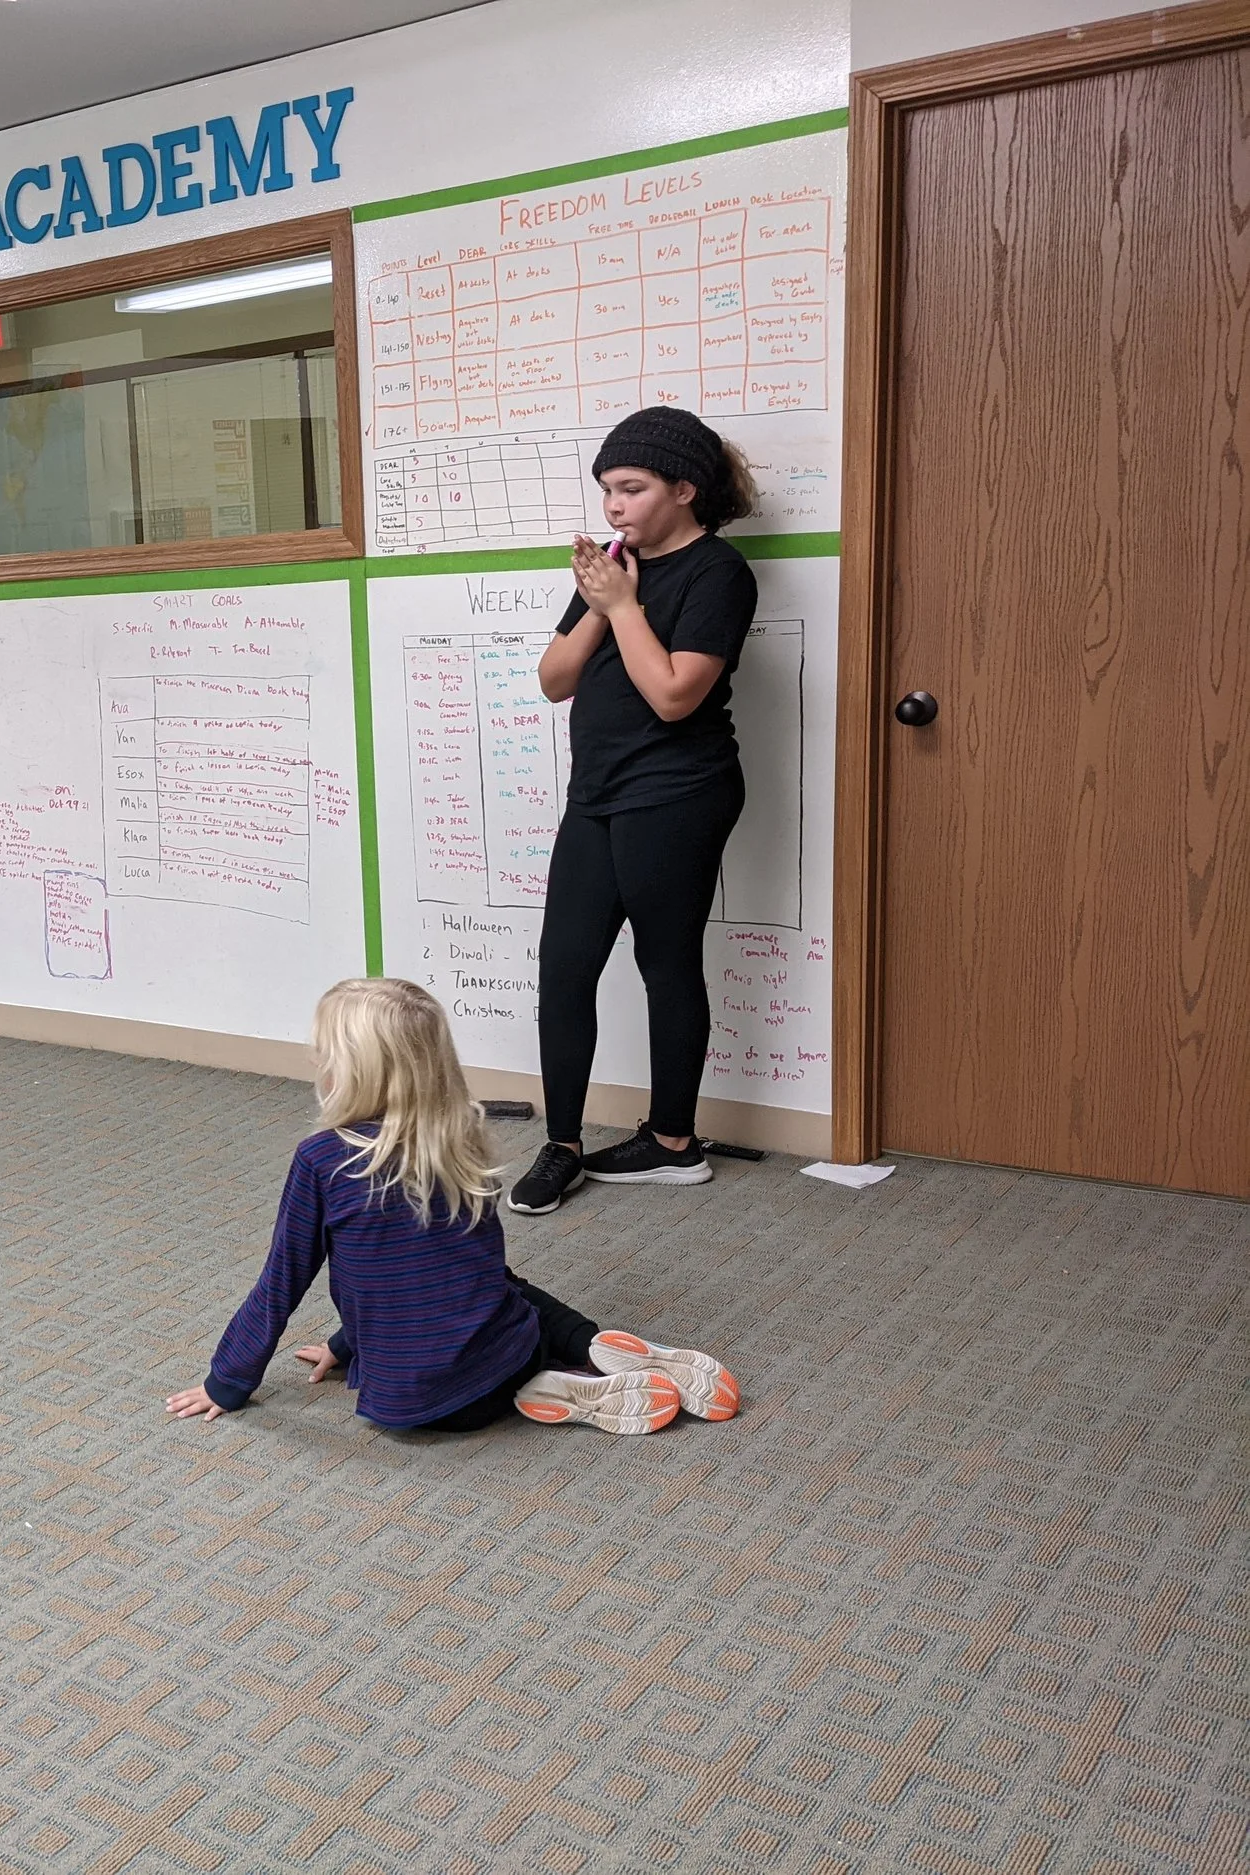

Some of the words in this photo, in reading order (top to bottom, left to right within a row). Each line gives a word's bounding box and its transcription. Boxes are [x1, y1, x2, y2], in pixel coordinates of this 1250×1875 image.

[500, 193, 607, 235] FREEDOM
[624, 171, 703, 206] LEVELS
[705, 198, 741, 212] LUNCH
[750, 193, 773, 205] Desk
[589, 224, 612, 234] FREE
[418, 251, 441, 268] Level
[459, 247, 487, 260] DEAR
[657, 246, 681, 260] N/A
[506, 271, 518, 282] At
[771, 273, 807, 287] designed
[417, 284, 446, 300] Reset
[774, 290, 784, 300] by
[658, 295, 679, 307] Yes
[594, 304, 607, 314] 30
[510, 314, 521, 326] At
[704, 333, 742, 347] Anywhere
[658, 343, 678, 357] Yes
[545, 355, 555, 363] or
[594, 352, 607, 362] 30
[420, 374, 453, 391] Flying
[751, 382, 790, 393] Designed
[798, 380, 807, 391] by
[509, 403, 556, 419] Anywhere
[595, 399, 609, 411] 30
[380, 462, 398, 470] DEAR
[412, 474, 416, 483] 5
[443, 472, 456, 480] 10
[415, 494, 428, 503] 10
[450, 492, 461, 502] 10
[416, 517, 424, 527] 5
[211, 594, 243, 607] GOALS
[465, 577, 555, 615] WEEKLY
[419, 637, 452, 645] MONDAY
[490, 636, 524, 645] TUESDAY
[111, 700, 129, 714] Ava
[259, 720, 283, 732] today
[514, 714, 541, 725] DEAR
[116, 725, 136, 744] Van
[117, 765, 144, 780] Esox
[49, 800, 64, 809] Oct
[120, 796, 148, 809] Malia
[123, 827, 148, 843] Klara
[527, 846, 550, 856] Slime
[124, 863, 150, 878] Lucca
[499, 871, 522, 884] 2:45
[257, 881, 281, 892] today
[442, 913, 512, 936] Halloween
[450, 942, 494, 962] Diwali
[426, 974, 436, 986] 3.
[454, 999, 515, 1020] Christmas
[746, 1046, 758, 1060] do
[770, 1051, 784, 1062] we
